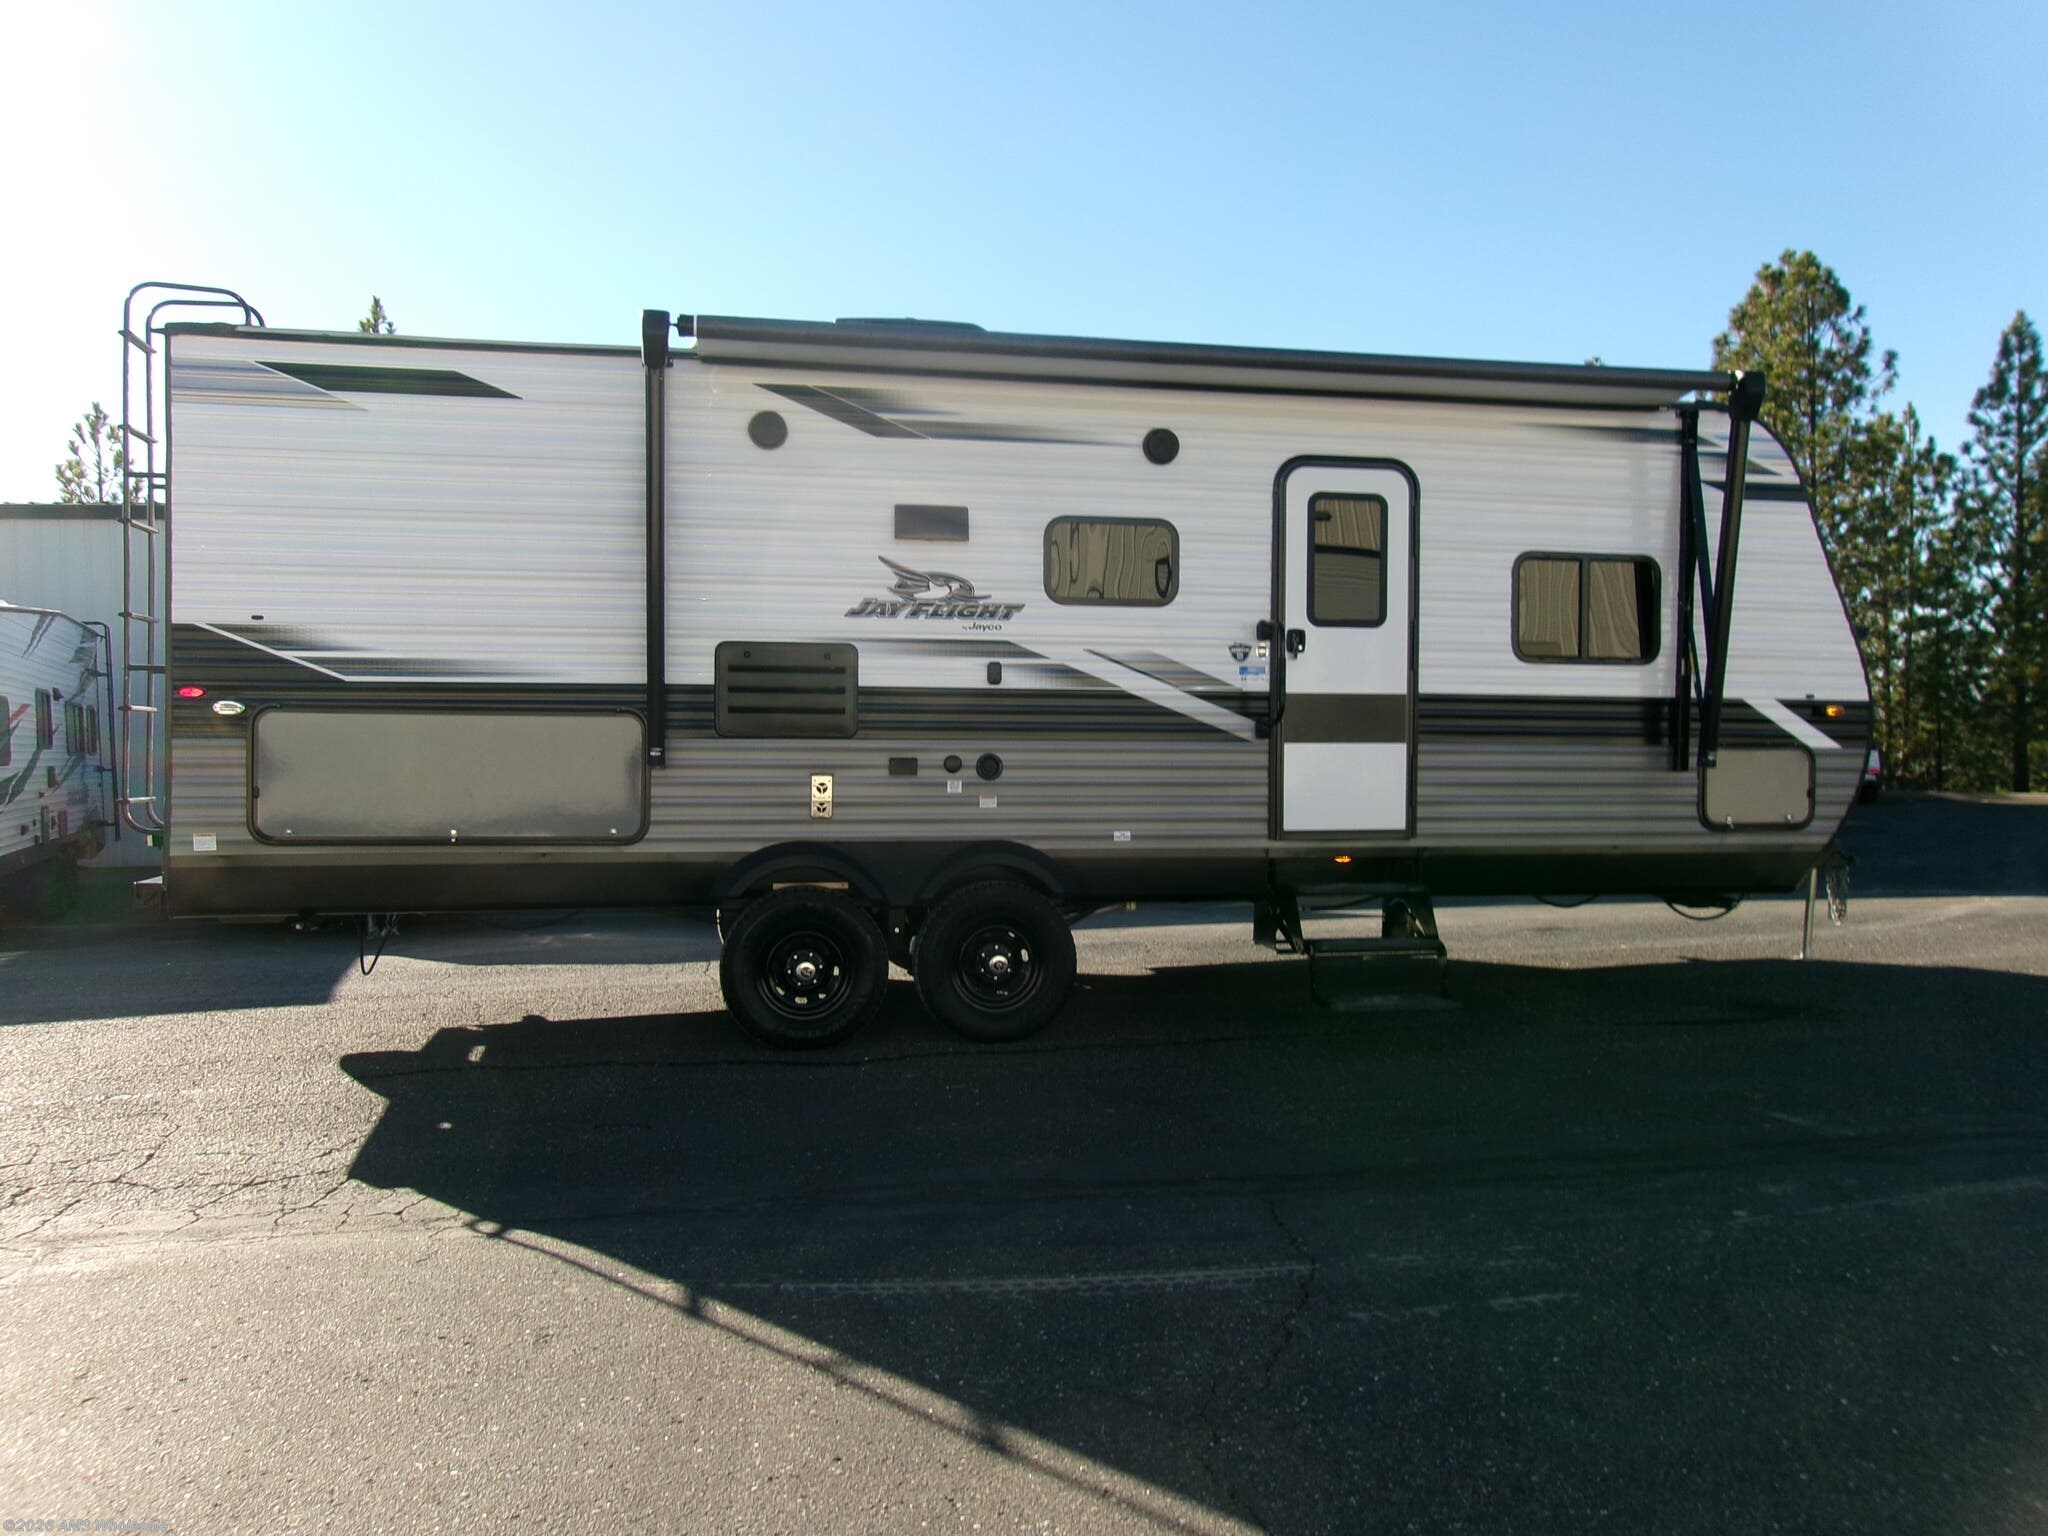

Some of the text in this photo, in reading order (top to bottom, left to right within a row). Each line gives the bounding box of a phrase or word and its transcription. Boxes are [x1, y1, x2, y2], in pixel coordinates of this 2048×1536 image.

[844, 598, 1025, 620] JAY FLIGHT
[968, 621, 1002, 632] Jayco
